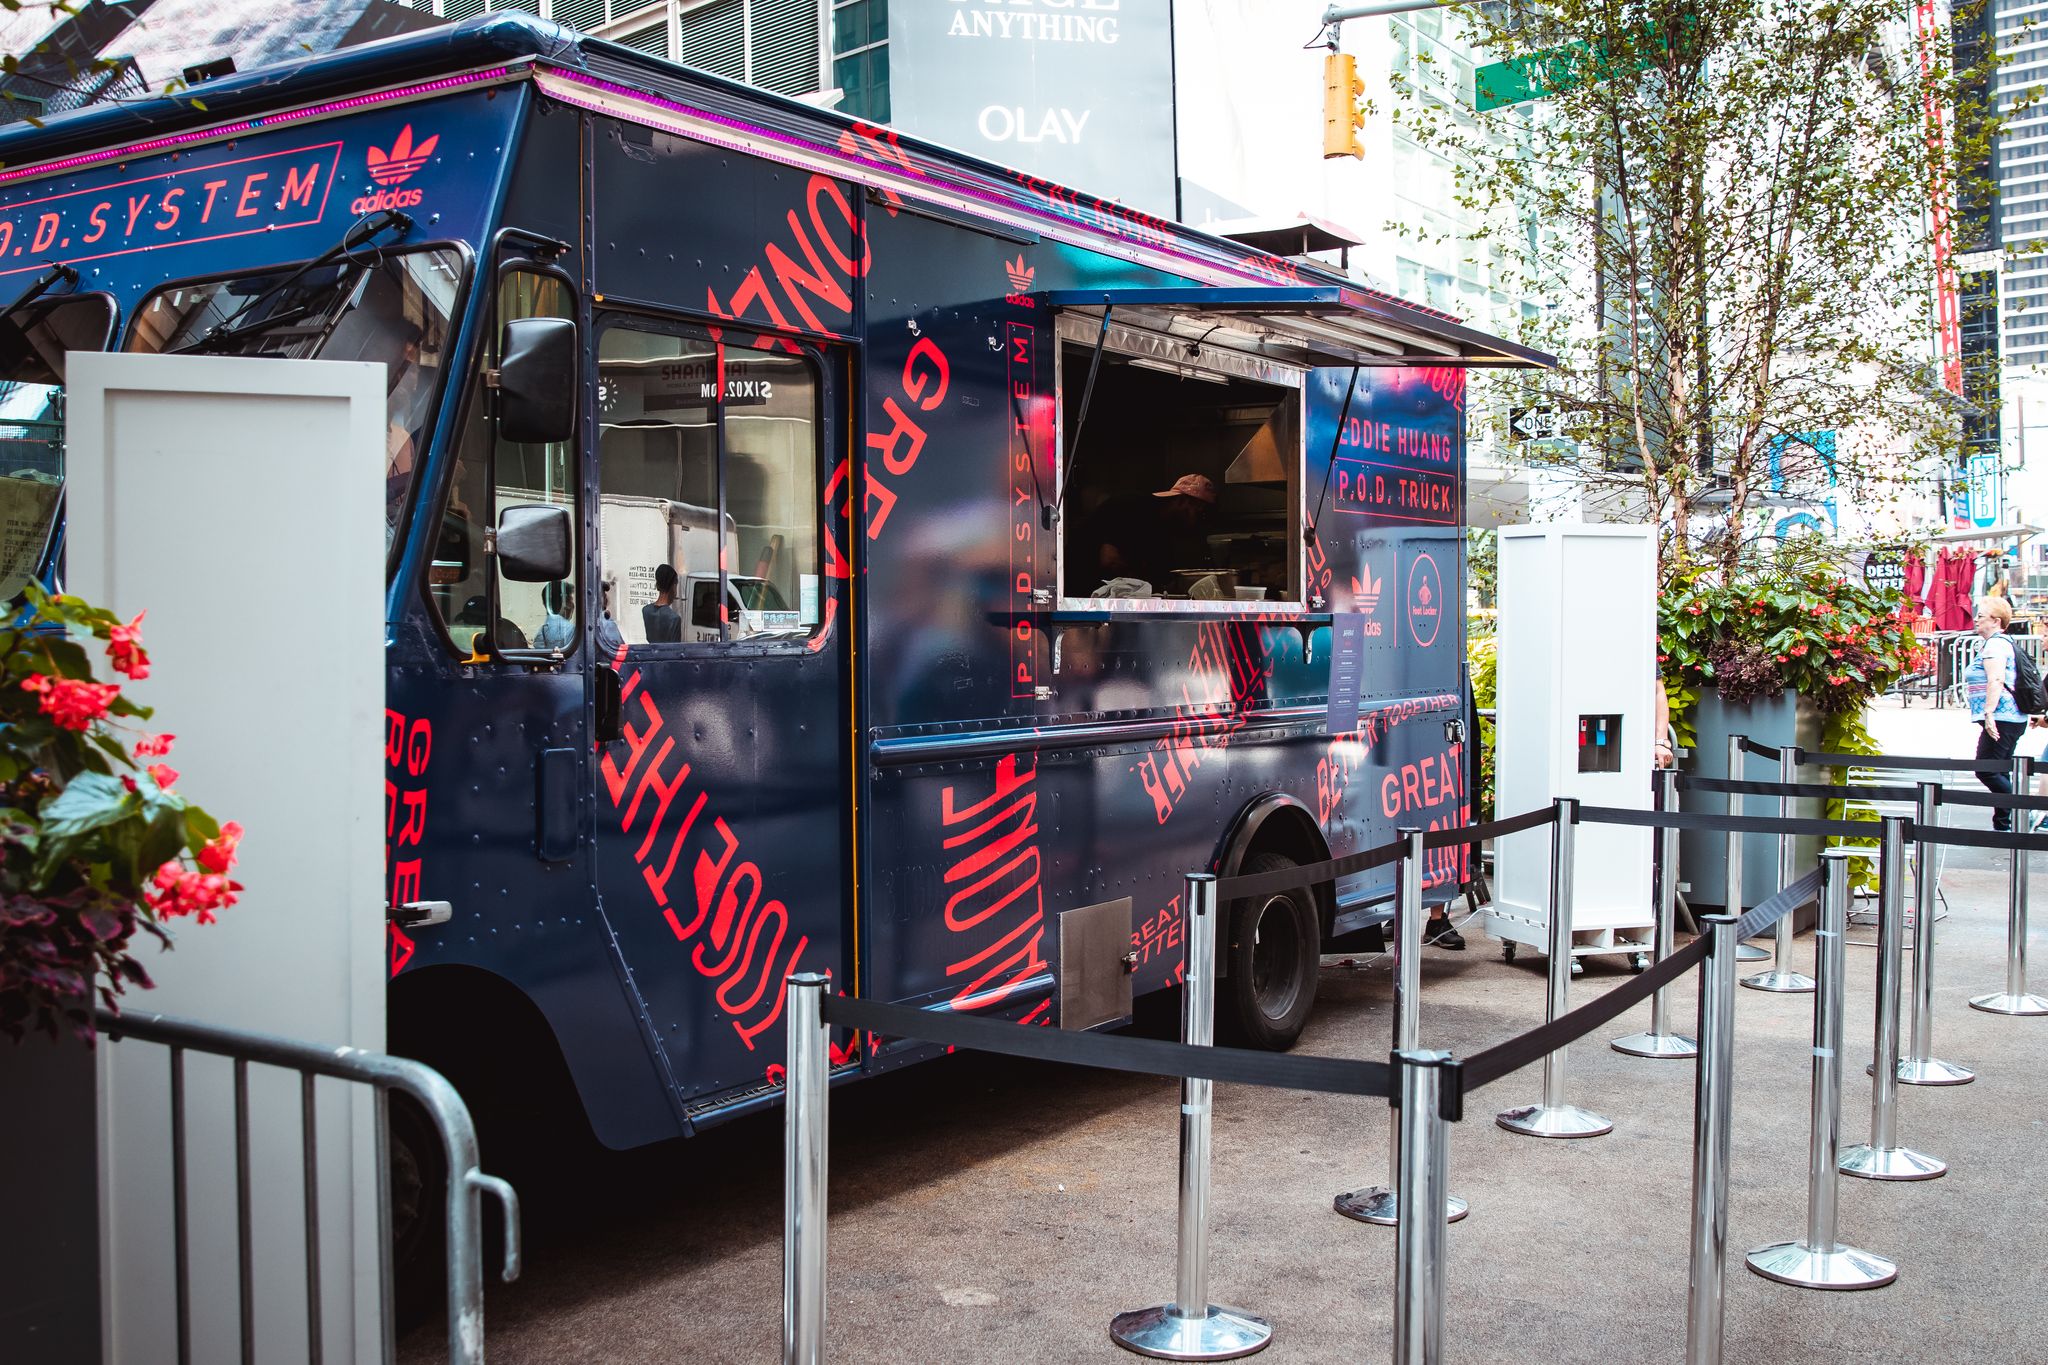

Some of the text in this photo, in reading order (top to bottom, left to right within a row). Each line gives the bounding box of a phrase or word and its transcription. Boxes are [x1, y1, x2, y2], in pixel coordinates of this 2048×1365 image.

[948, 9, 1120, 44] ANYTHING
[978, 105, 1091, 144] OLAY
[351, 187, 423, 215] adidas
[1006, 293, 1034, 308] adidas
[1339, 415, 1451, 463] EDDIE HUANG
[1524, 414, 1552, 430] ONE
[1339, 470, 1451, 513] P.O.D. TRUCK
[1866, 564, 1905, 577] DESI
[1383, 693, 1459, 733] TOGETHER
[1381, 742, 1464, 819] GREAT
